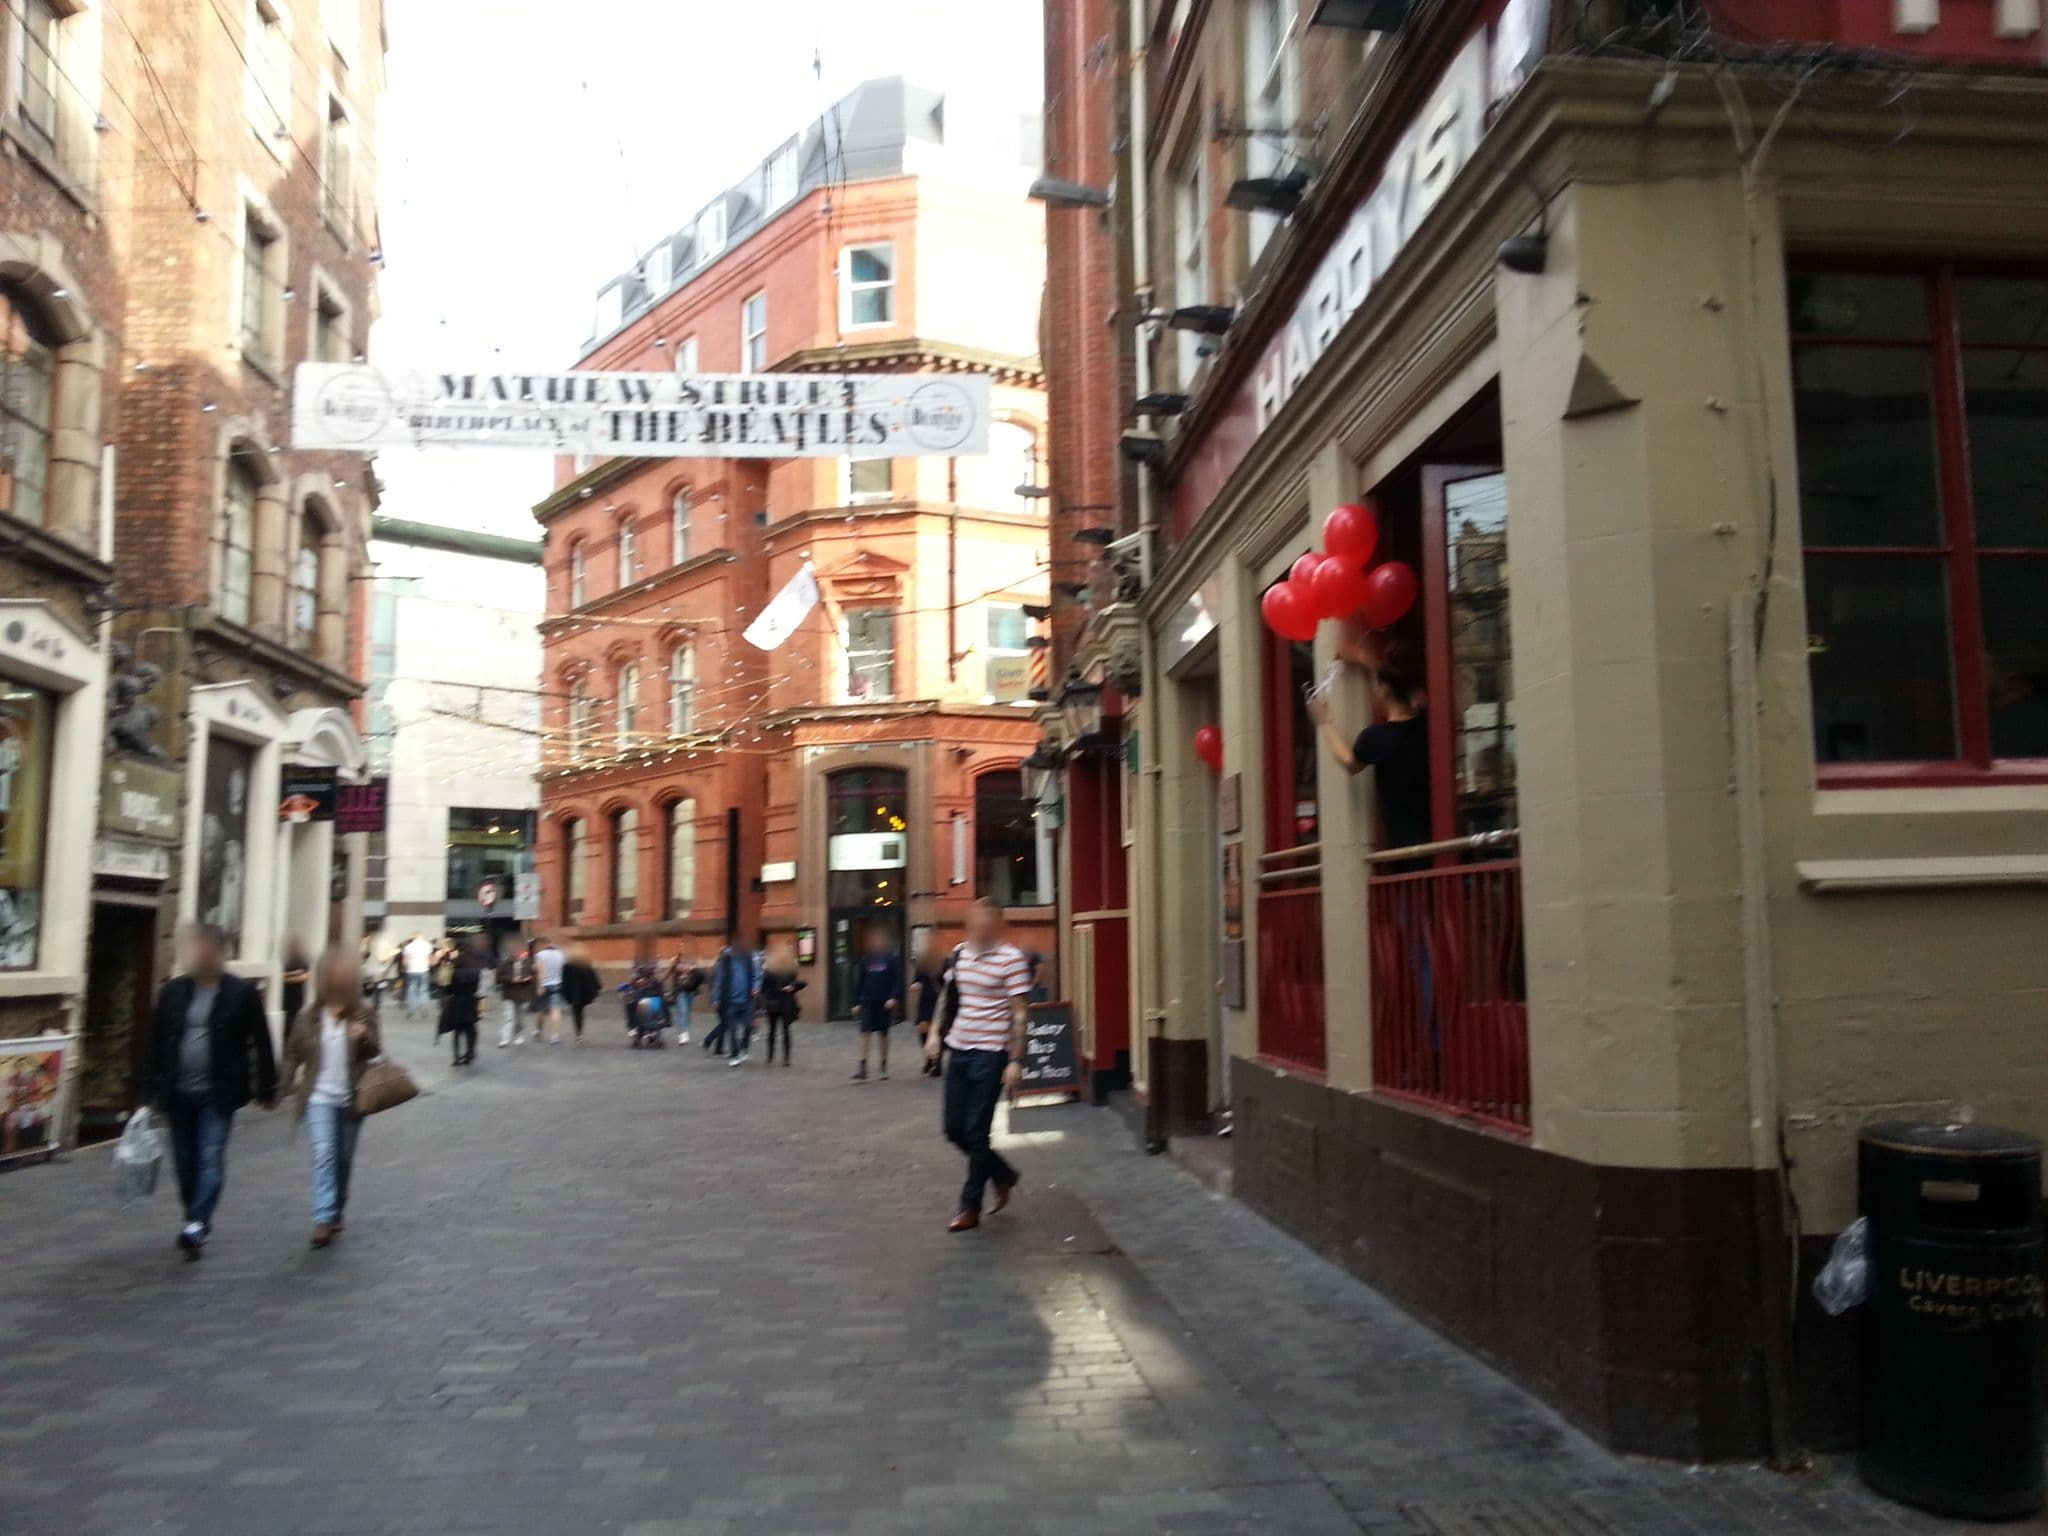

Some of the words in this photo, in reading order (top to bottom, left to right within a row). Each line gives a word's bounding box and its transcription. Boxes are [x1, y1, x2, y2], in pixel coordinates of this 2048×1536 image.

[436, 374, 656, 405] MATHEW
[680, 379, 863, 406] STREET
[603, 410, 689, 444] THE
[701, 411, 888, 446] BEATLES
